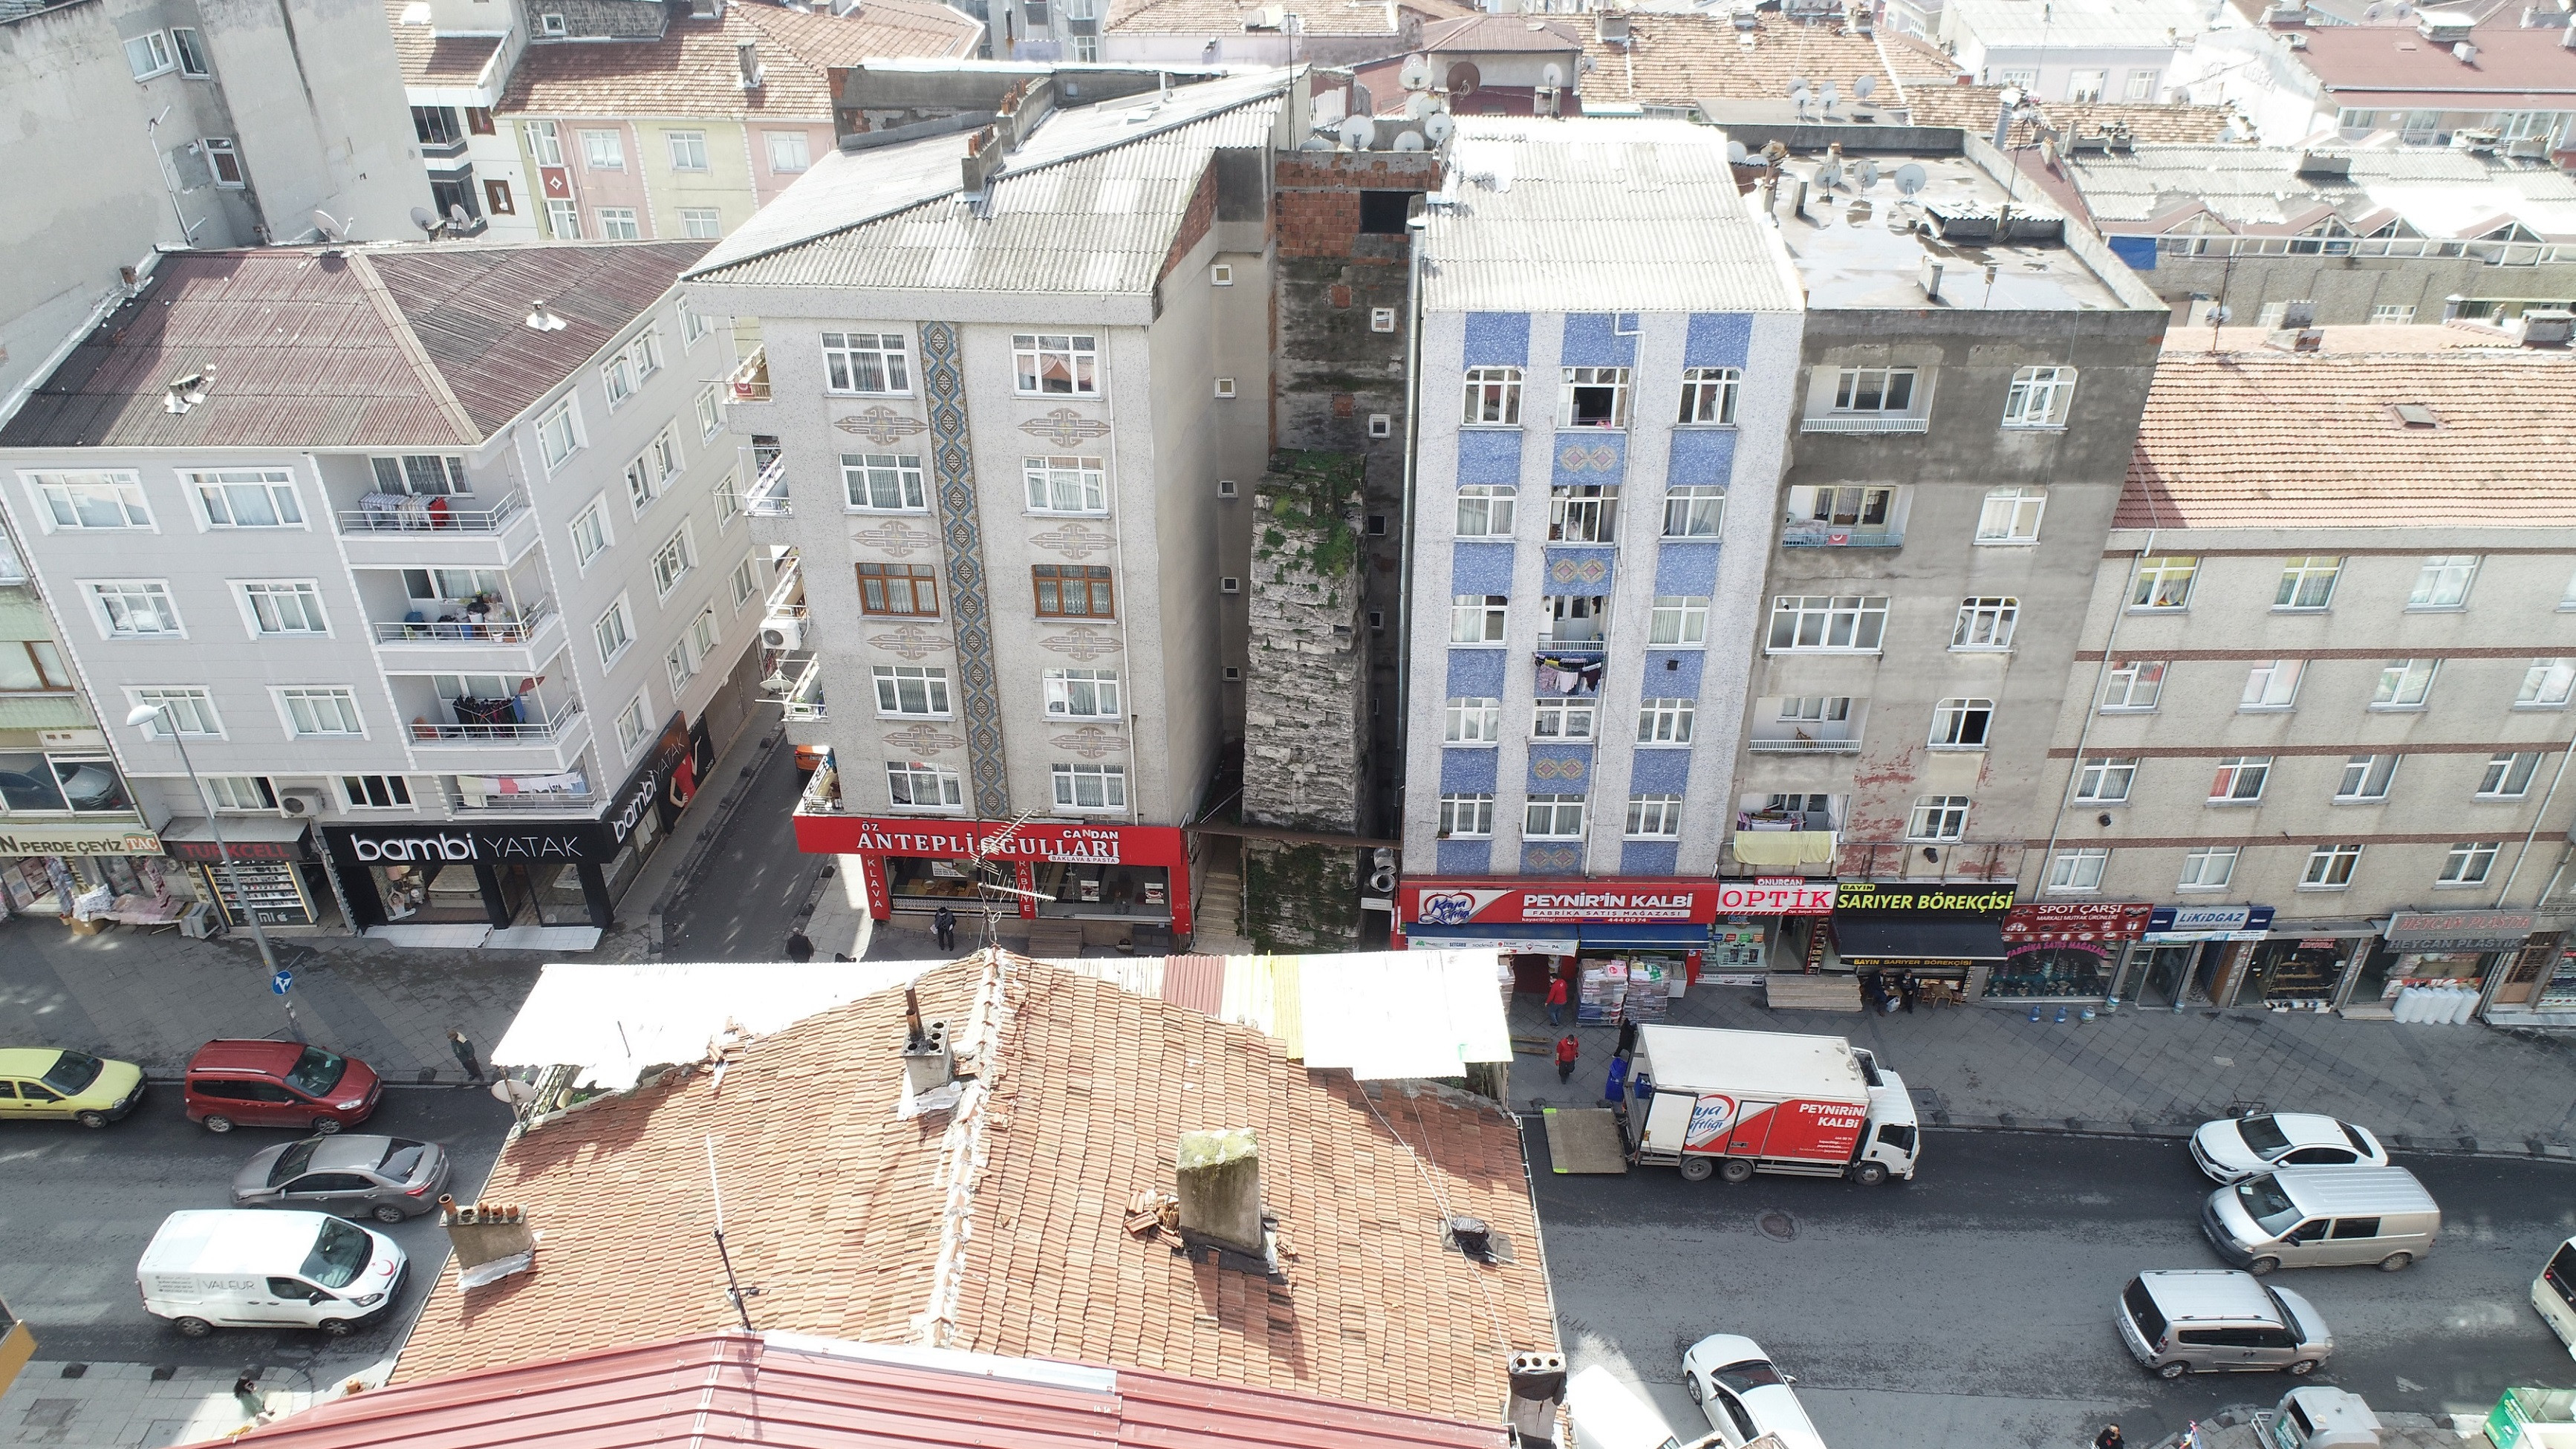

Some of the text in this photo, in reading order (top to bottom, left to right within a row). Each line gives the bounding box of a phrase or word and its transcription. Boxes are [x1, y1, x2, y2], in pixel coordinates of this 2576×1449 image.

[611, 732, 685, 844] bambi YATAK
[862, 821, 879, 831] ÖZ
[1063, 829, 1119, 839] CANDAN
[20, 841, 74, 853] PERDE
[77, 839, 125, 854] ÇEYİZ
[126, 836, 158, 851] TAÇ
[350, 832, 582, 861] bambi YATAK
[866, 854, 882, 908] KLAVA
[1427, 896, 1467, 915] Kaya
[1630, 893, 1694, 908] KALBİ
[1722, 889, 1832, 908] OPTİK
[1837, 890, 2014, 914] SARIYER BÖREKÇİSİ
[2037, 905, 2123, 916] SPOT ÇARŞI
[2397, 917, 2465, 931] HEYCAN
[2006, 942, 2041, 958] FABRİKA
[2389, 940, 2455, 948] HEYCAN
[203, 1280, 255, 1290] VALEUR
